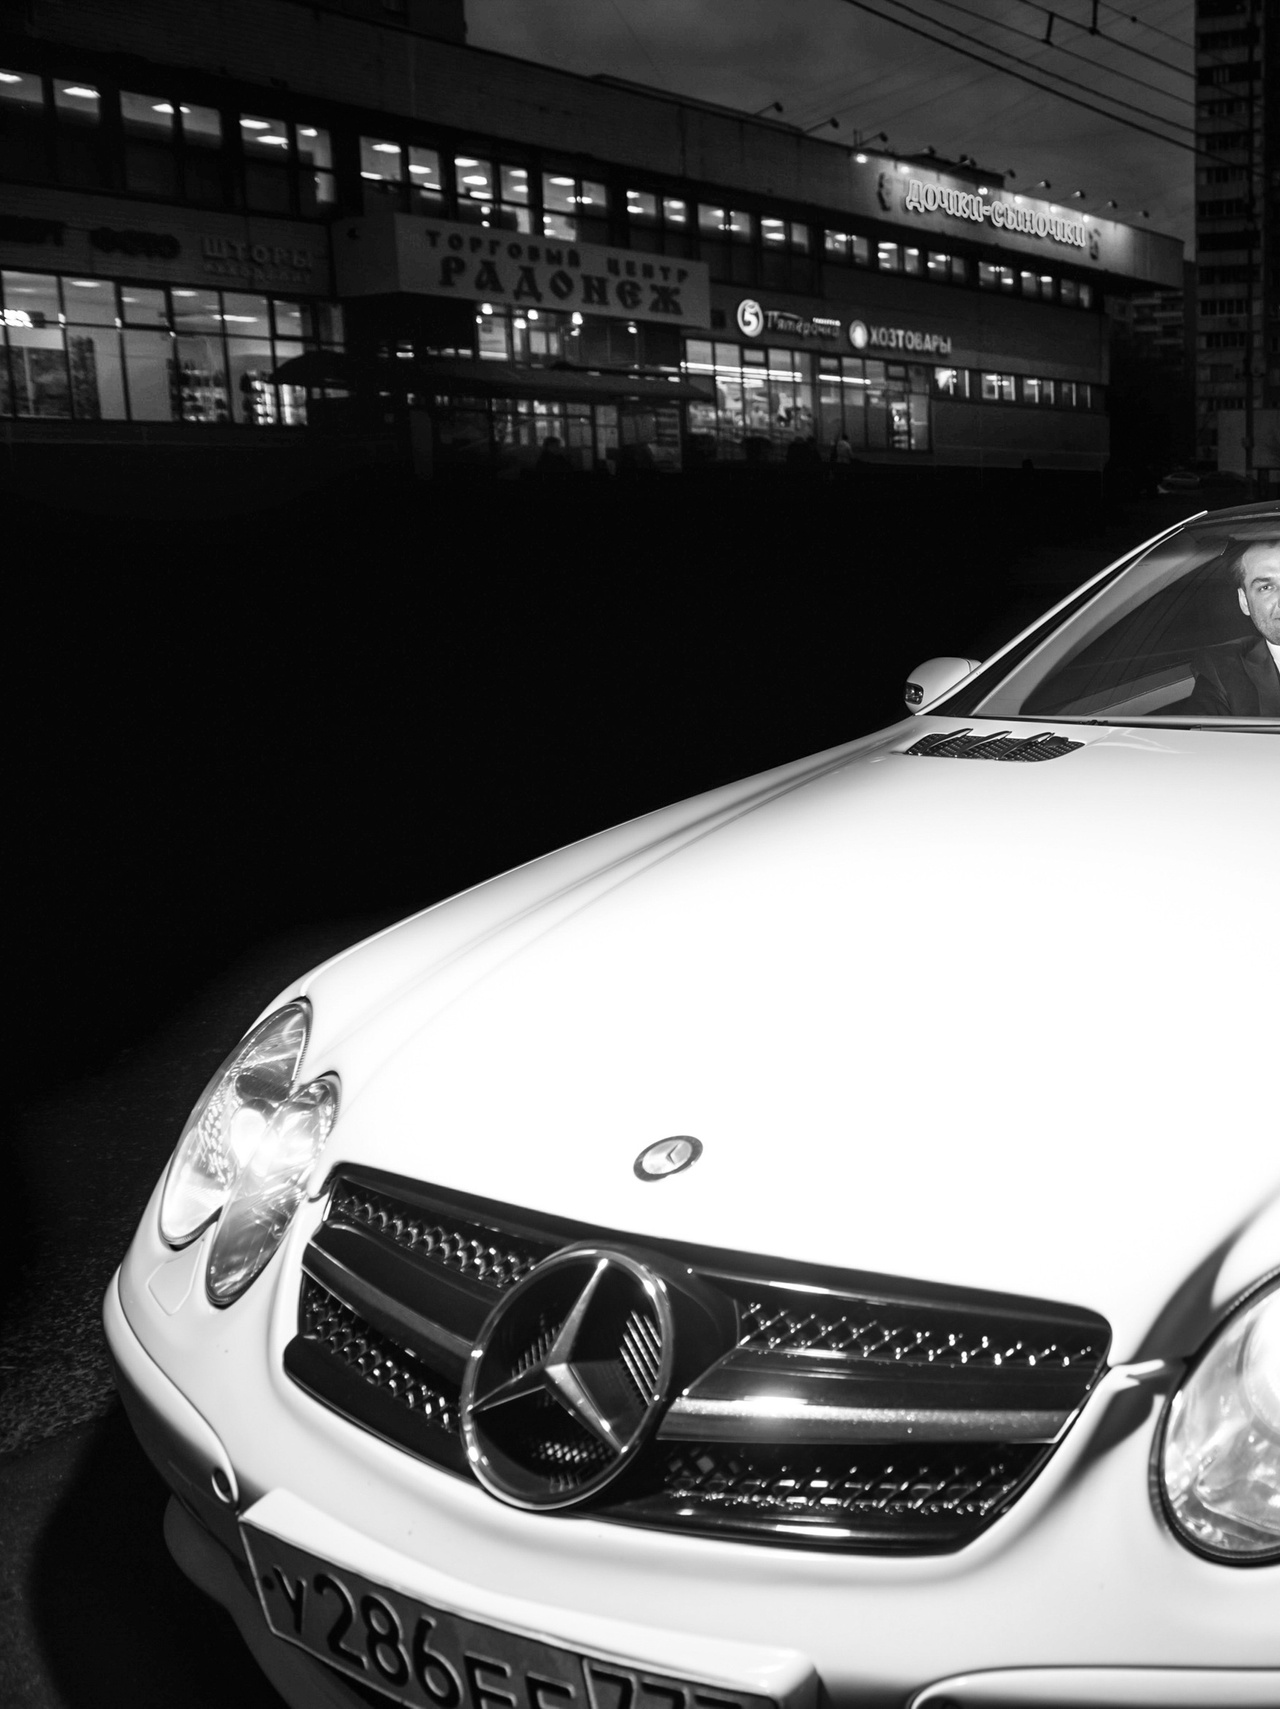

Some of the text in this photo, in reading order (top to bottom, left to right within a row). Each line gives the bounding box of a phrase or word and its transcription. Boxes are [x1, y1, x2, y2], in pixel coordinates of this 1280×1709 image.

[202, 237, 312, 268] ШТОРЫ
[426, 229, 689, 284] ТОРГОВЫЙ ЦЕНТР
[438, 255, 684, 316] РАДОНЕЖ
[869, 326, 952, 354] ХОЗТОВАРЫ
